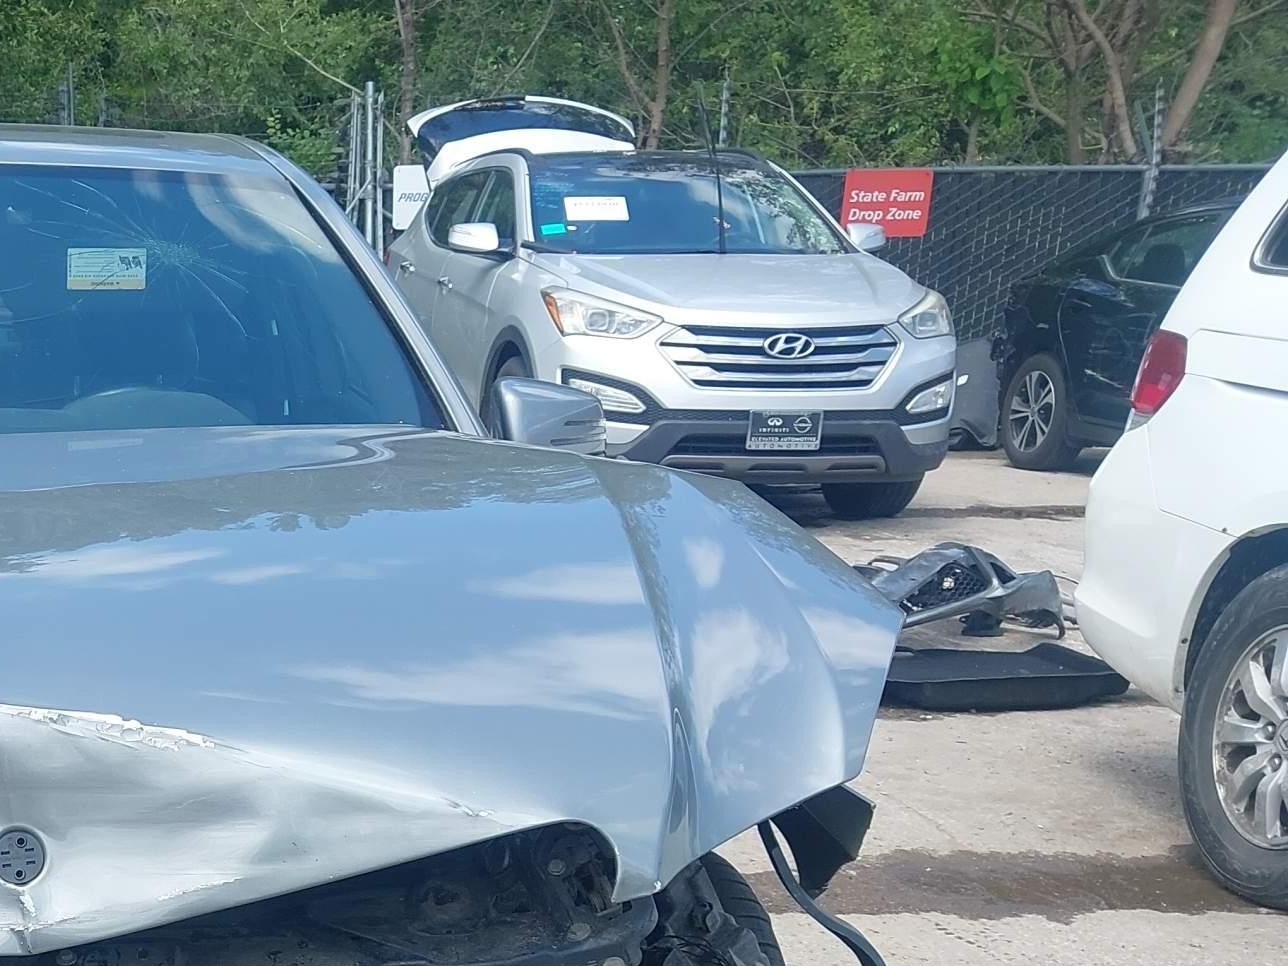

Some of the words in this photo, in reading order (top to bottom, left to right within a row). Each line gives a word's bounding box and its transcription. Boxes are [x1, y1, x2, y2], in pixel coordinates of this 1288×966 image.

[849, 189, 887, 203] State
[889, 189, 925, 202] Farm
[848, 208, 883, 223] Drop
[885, 208, 922, 220] Zone
